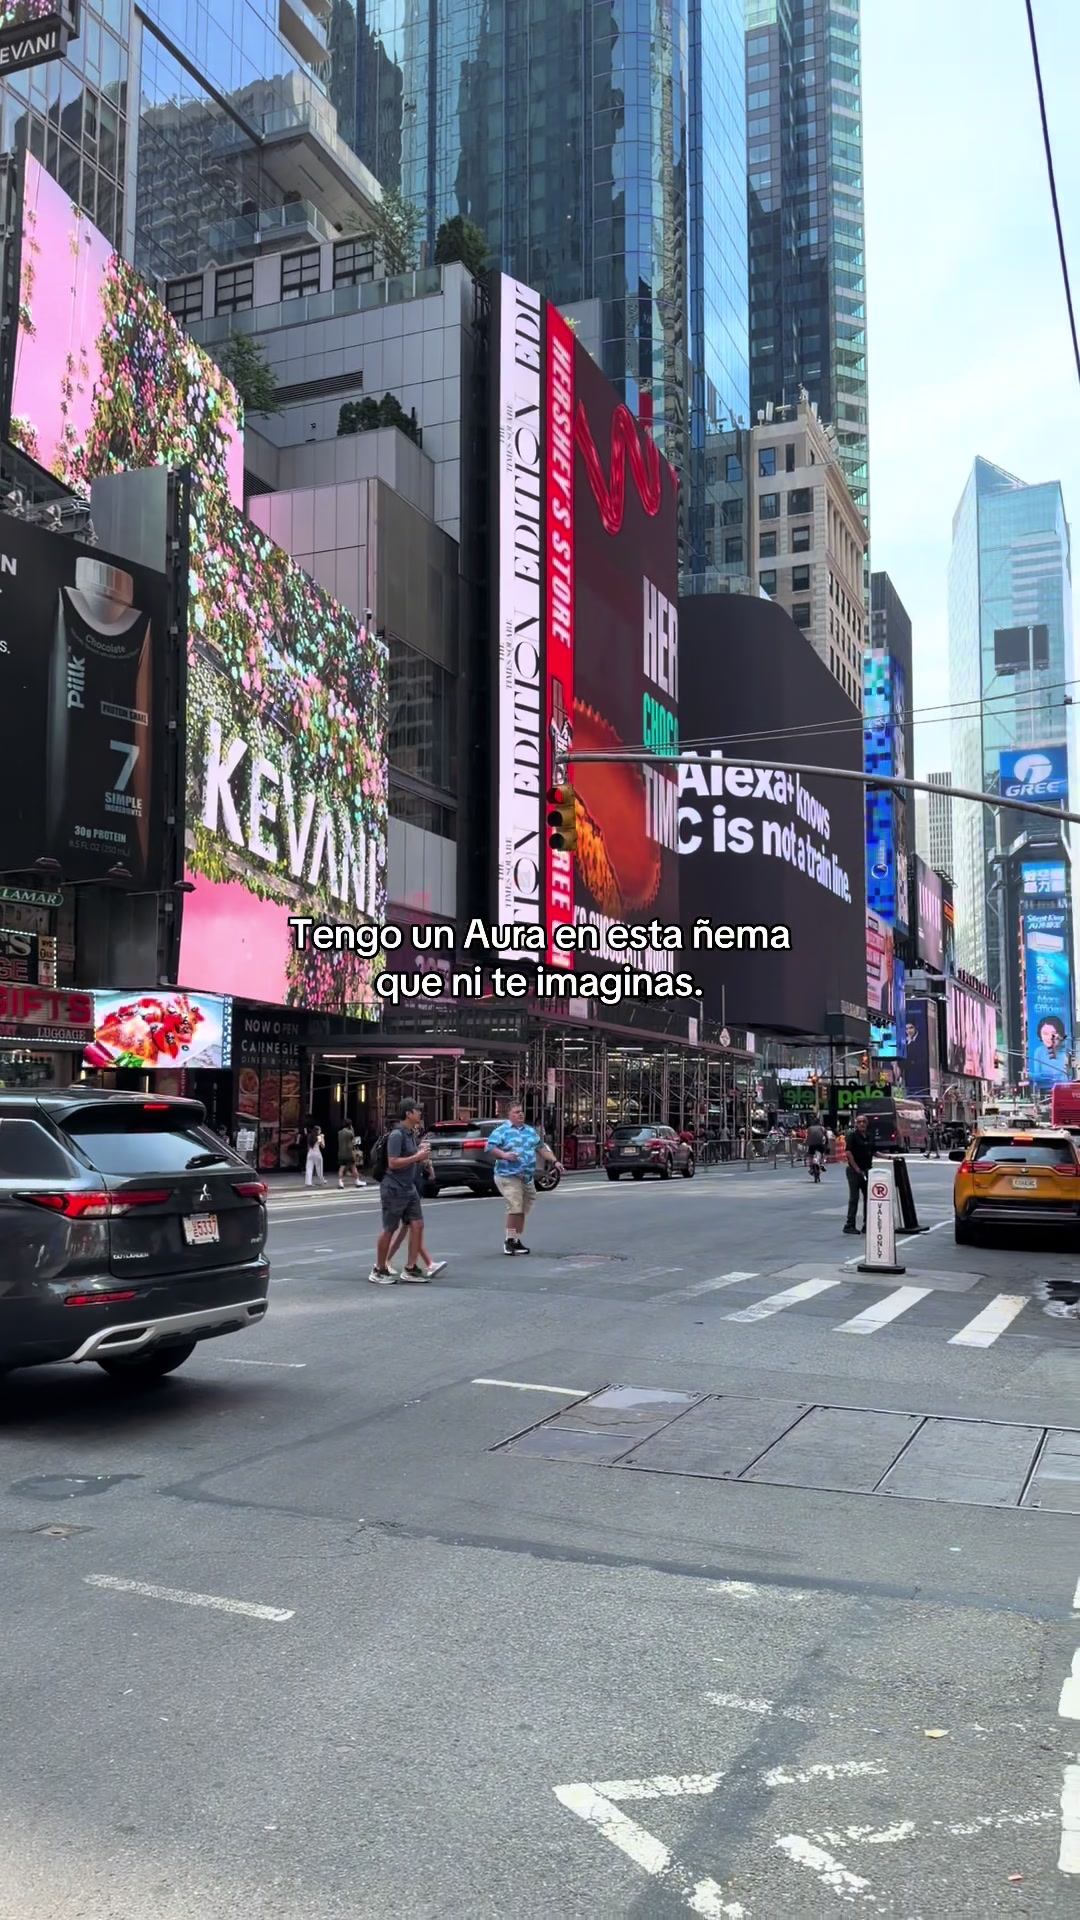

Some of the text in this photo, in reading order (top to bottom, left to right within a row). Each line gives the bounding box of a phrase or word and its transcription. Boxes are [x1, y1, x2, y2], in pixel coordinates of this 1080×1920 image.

[514, 392, 540, 586] EDITION
[551, 335, 571, 649] HERSHEY'S STORE
[85, 634, 126, 654] Chocolate
[514, 606, 540, 799] EDITION
[110, 740, 139, 792] 7
[1005, 781, 1063, 797] GREE
[105, 792, 142, 810] SIMPLE
[796, 773, 831, 841] knows
[203, 719, 377, 918] KEVANI
[74, 826, 127, 847] 30g PROTEIN
[713, 804, 754, 854] is
[762, 820, 797, 867] not
[798, 836, 806, 872] a
[806, 833, 832, 891] train
[2, 888, 57, 904] LAMAR
[37, 1027, 86, 1041] LUGGAGE
[244, 1018, 299, 1036] NOW OPEN
[241, 1039, 299, 1056] CARNEGIE
